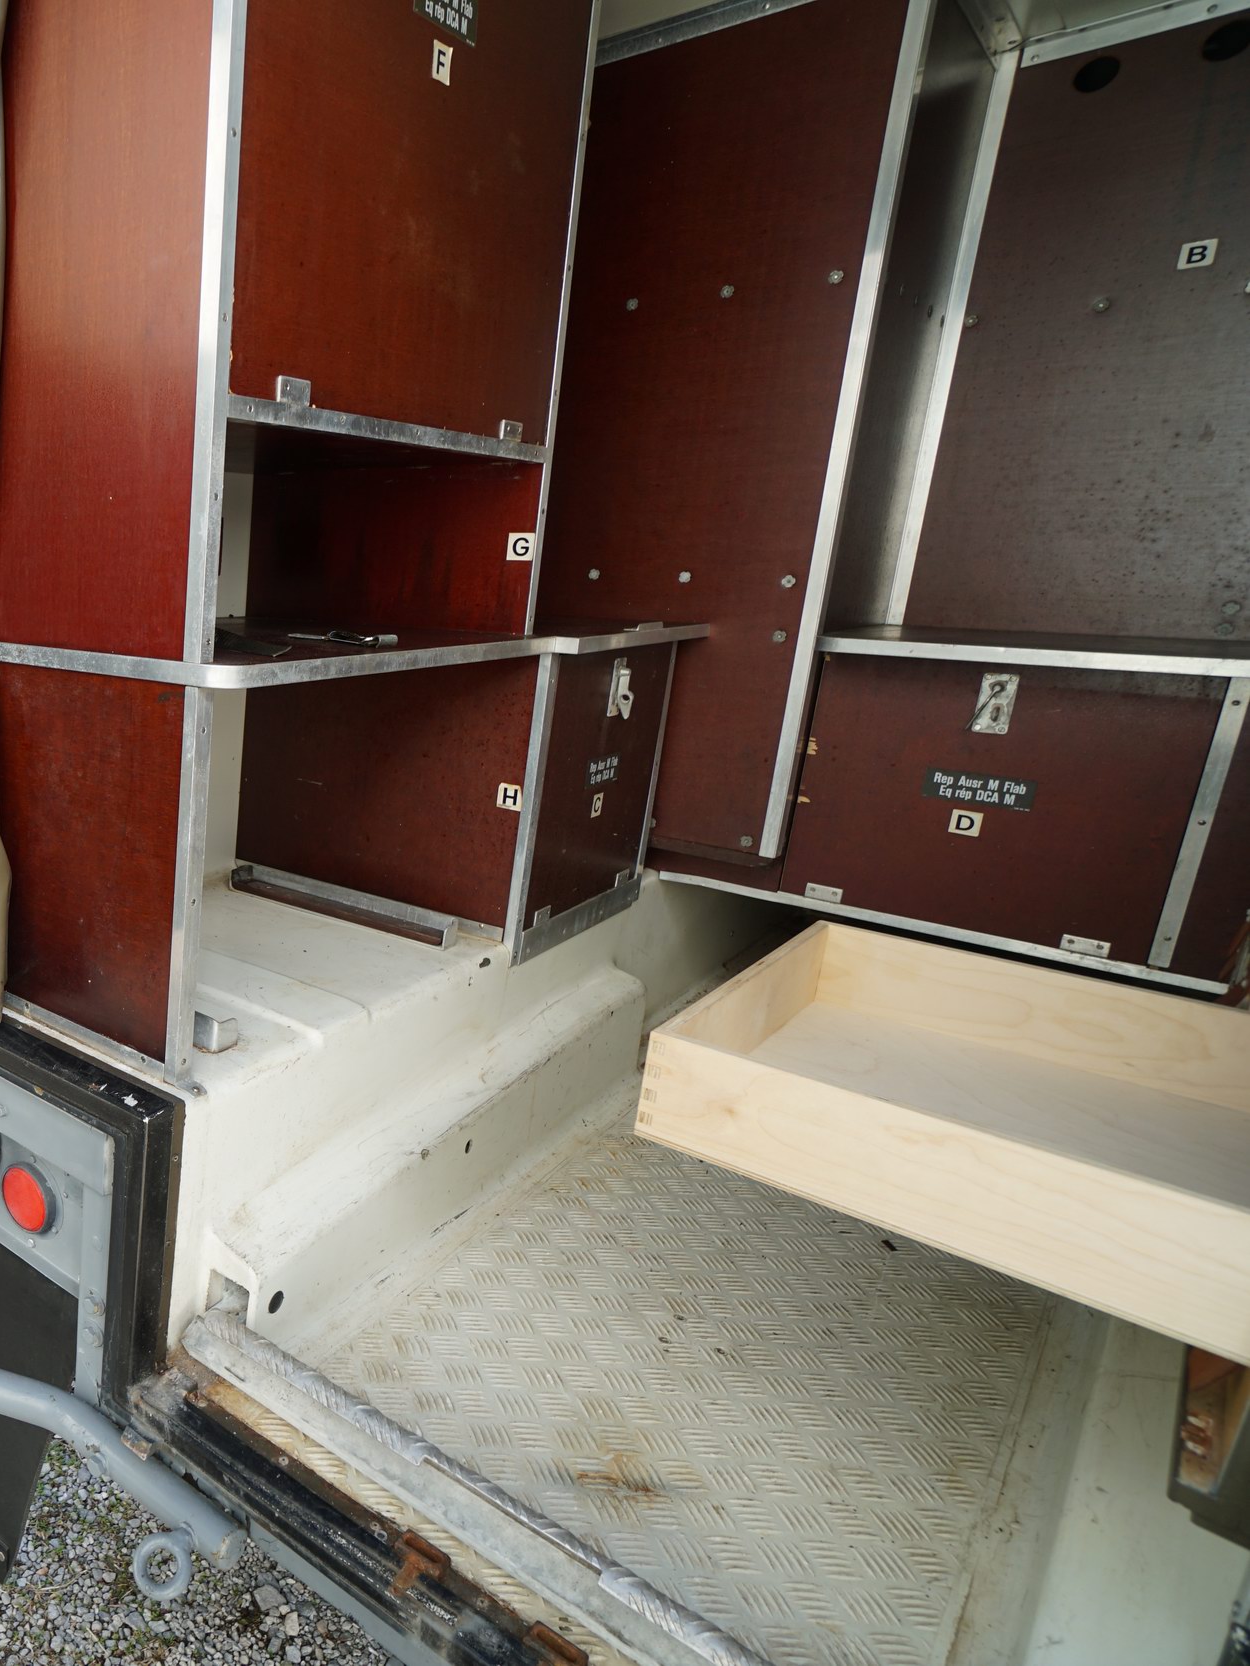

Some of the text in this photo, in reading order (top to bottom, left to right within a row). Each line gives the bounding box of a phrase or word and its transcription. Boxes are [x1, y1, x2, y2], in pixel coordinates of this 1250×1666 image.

[434, 2, 444, 23] rép
[446, 7, 459, 30] DCA
[461, 17, 468, 35] M
[436, 49, 446, 75] F
[1186, 245, 1208, 264] B
[512, 537, 529, 556] G
[934, 772, 1027, 795] Rep Ausr M Flab
[502, 787, 518, 806] H
[594, 796, 601, 813] C
[939, 785, 1016, 806] Eq rép DCA M
[955, 814, 975, 831] D
